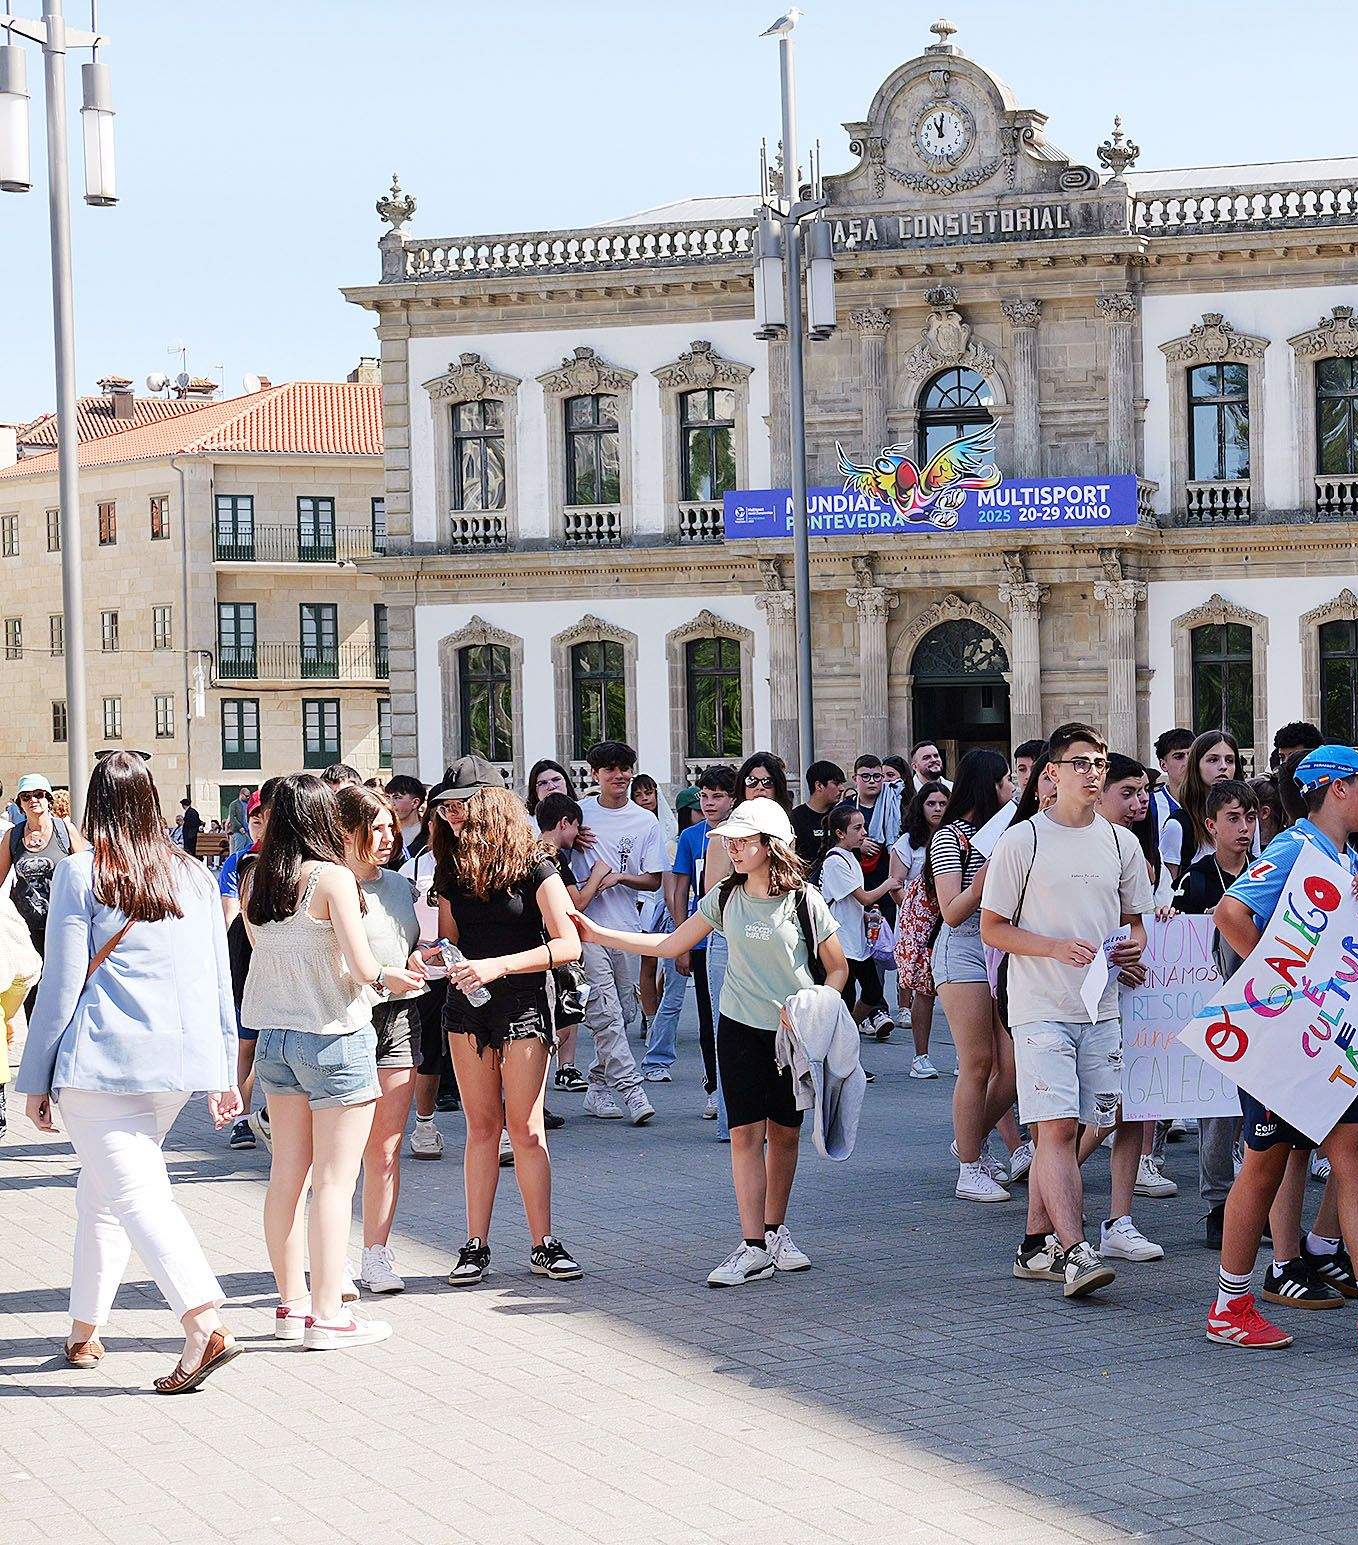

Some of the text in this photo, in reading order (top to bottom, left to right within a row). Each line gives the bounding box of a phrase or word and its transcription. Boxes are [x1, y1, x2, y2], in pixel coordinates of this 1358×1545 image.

[827, 205, 1071, 244] ASA CONSISTORIAL
[977, 484, 1110, 507] MULTISPORT
[786, 512, 906, 531] PNTEVEDRA
[978, 509, 1011, 523] 2025
[1018, 506, 1061, 522] 20-29
[1063, 501, 1111, 520] XUÑO
